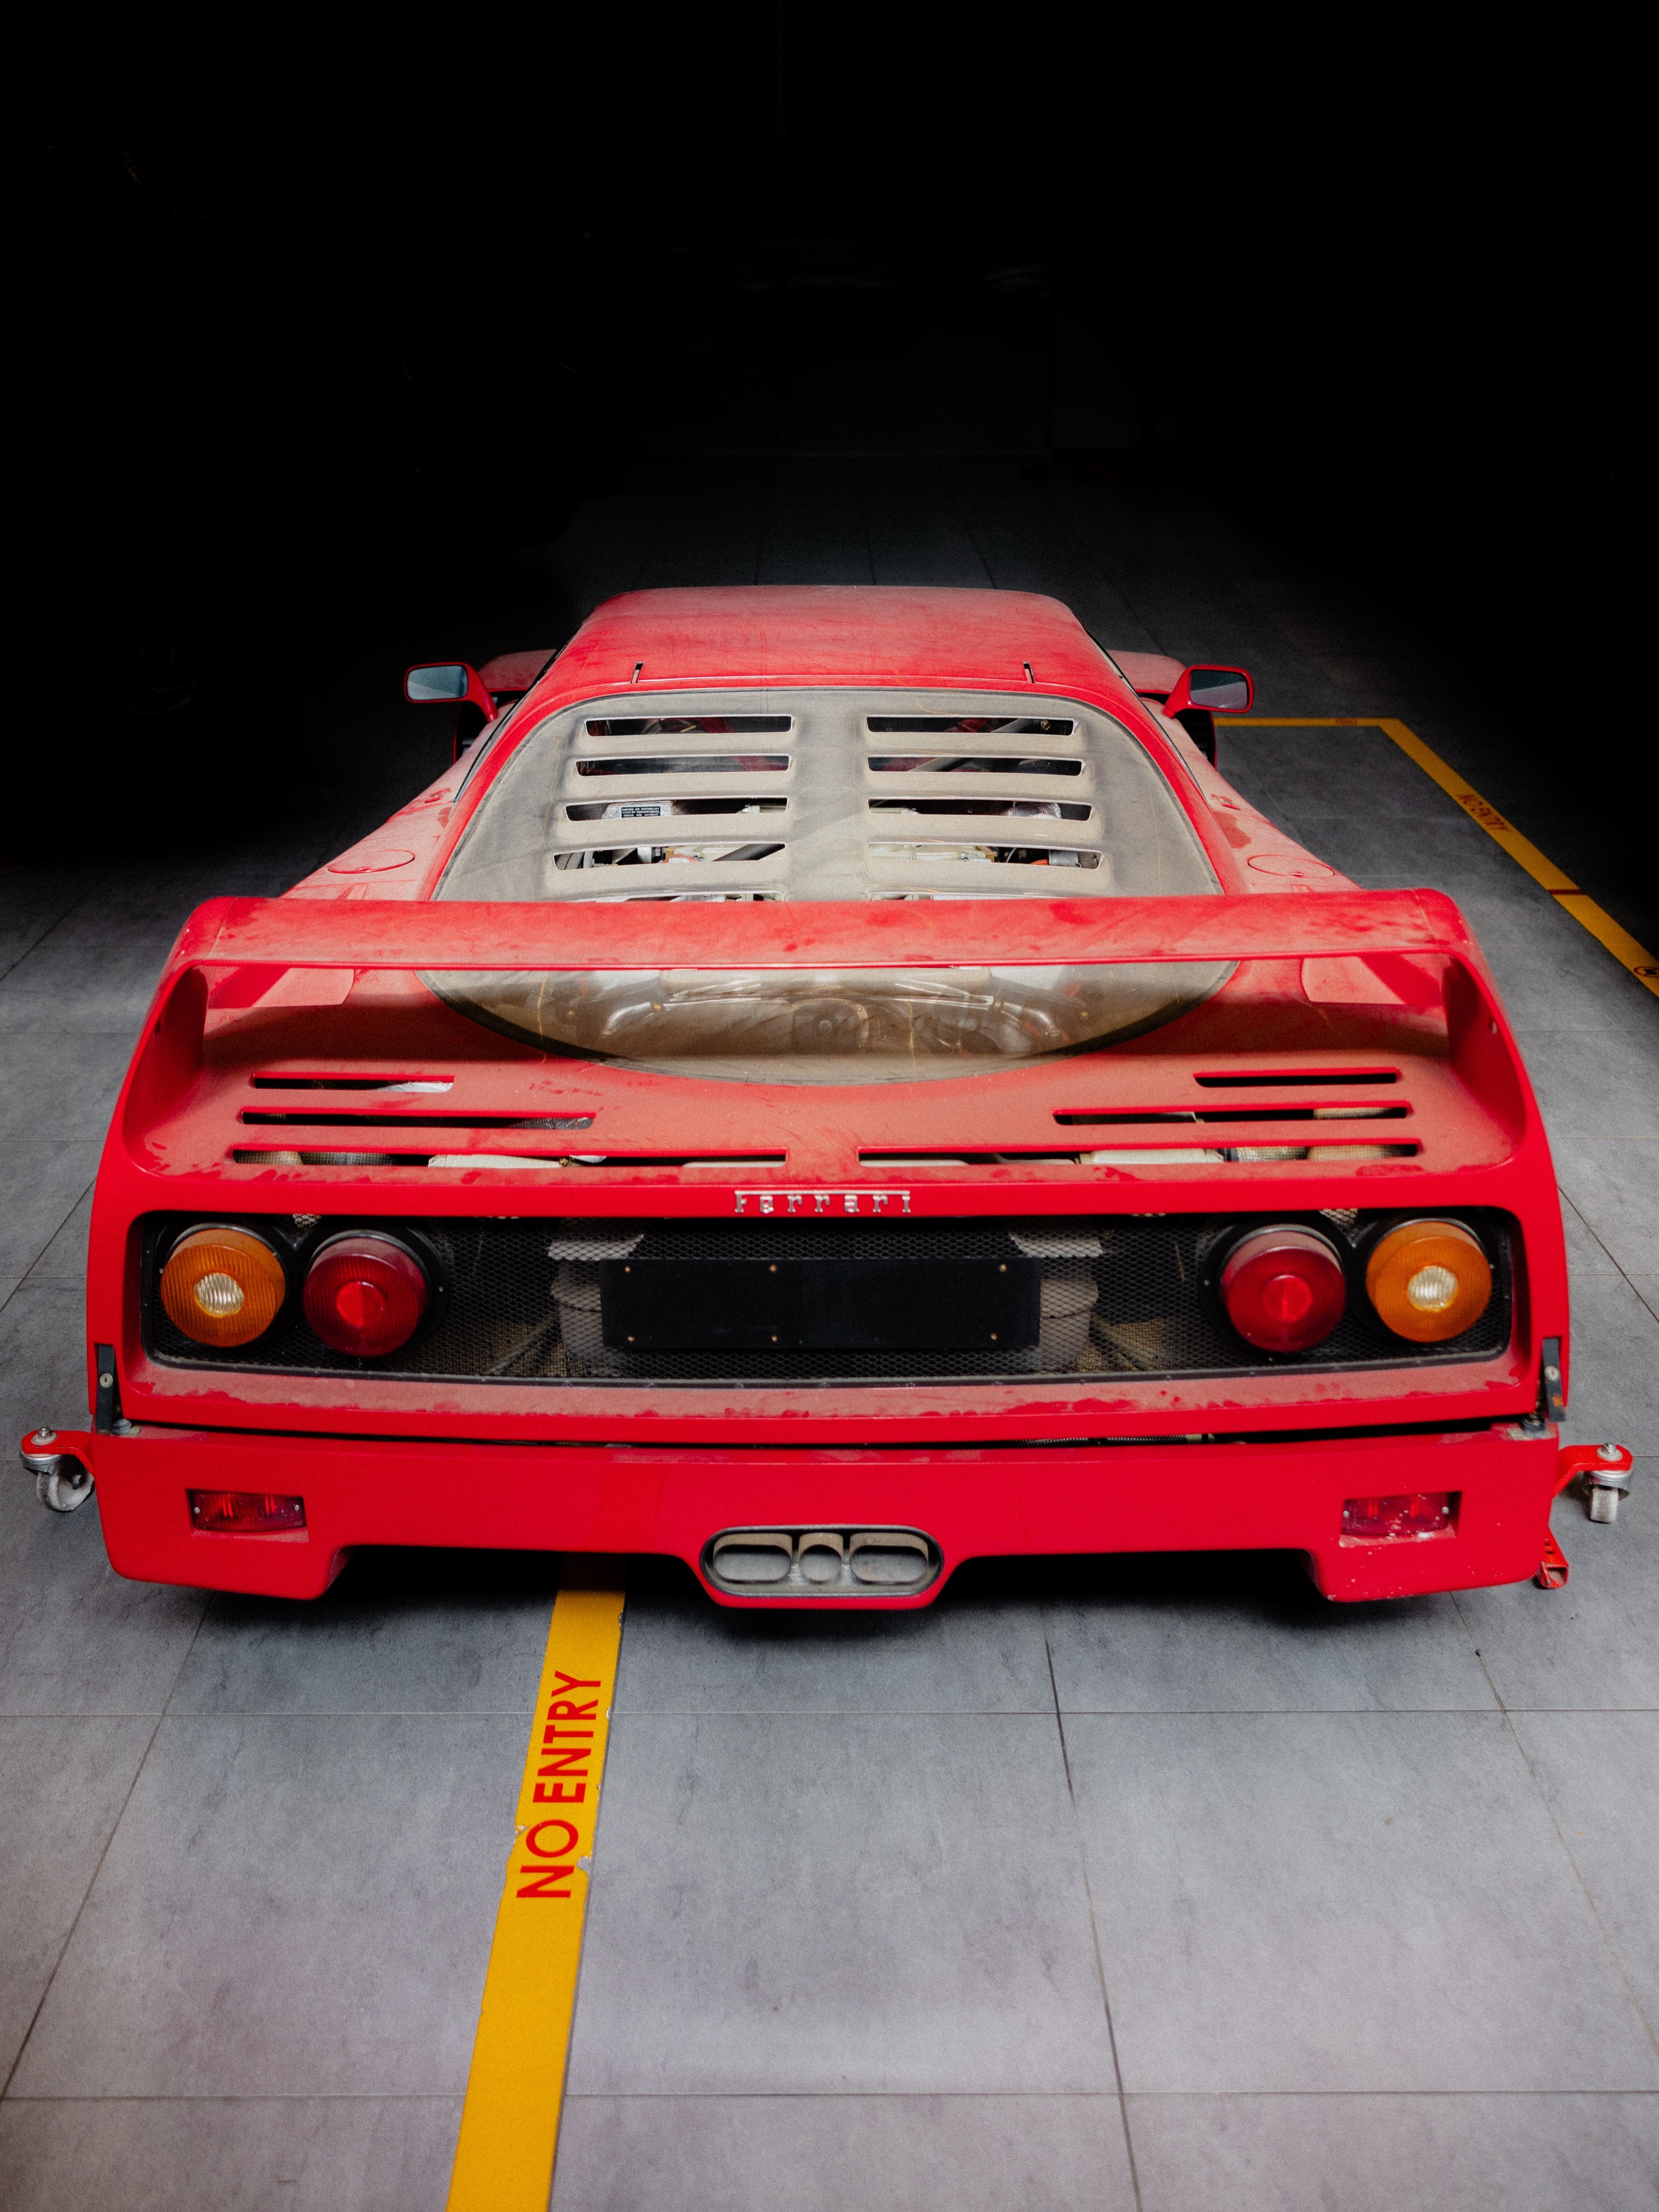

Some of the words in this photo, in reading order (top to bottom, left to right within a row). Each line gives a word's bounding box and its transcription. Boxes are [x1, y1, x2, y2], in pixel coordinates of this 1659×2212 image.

[734, 1190, 911, 1213] Ferrari
[532, 1670, 601, 1803] ENTRY
[516, 1819, 579, 1898] NO
